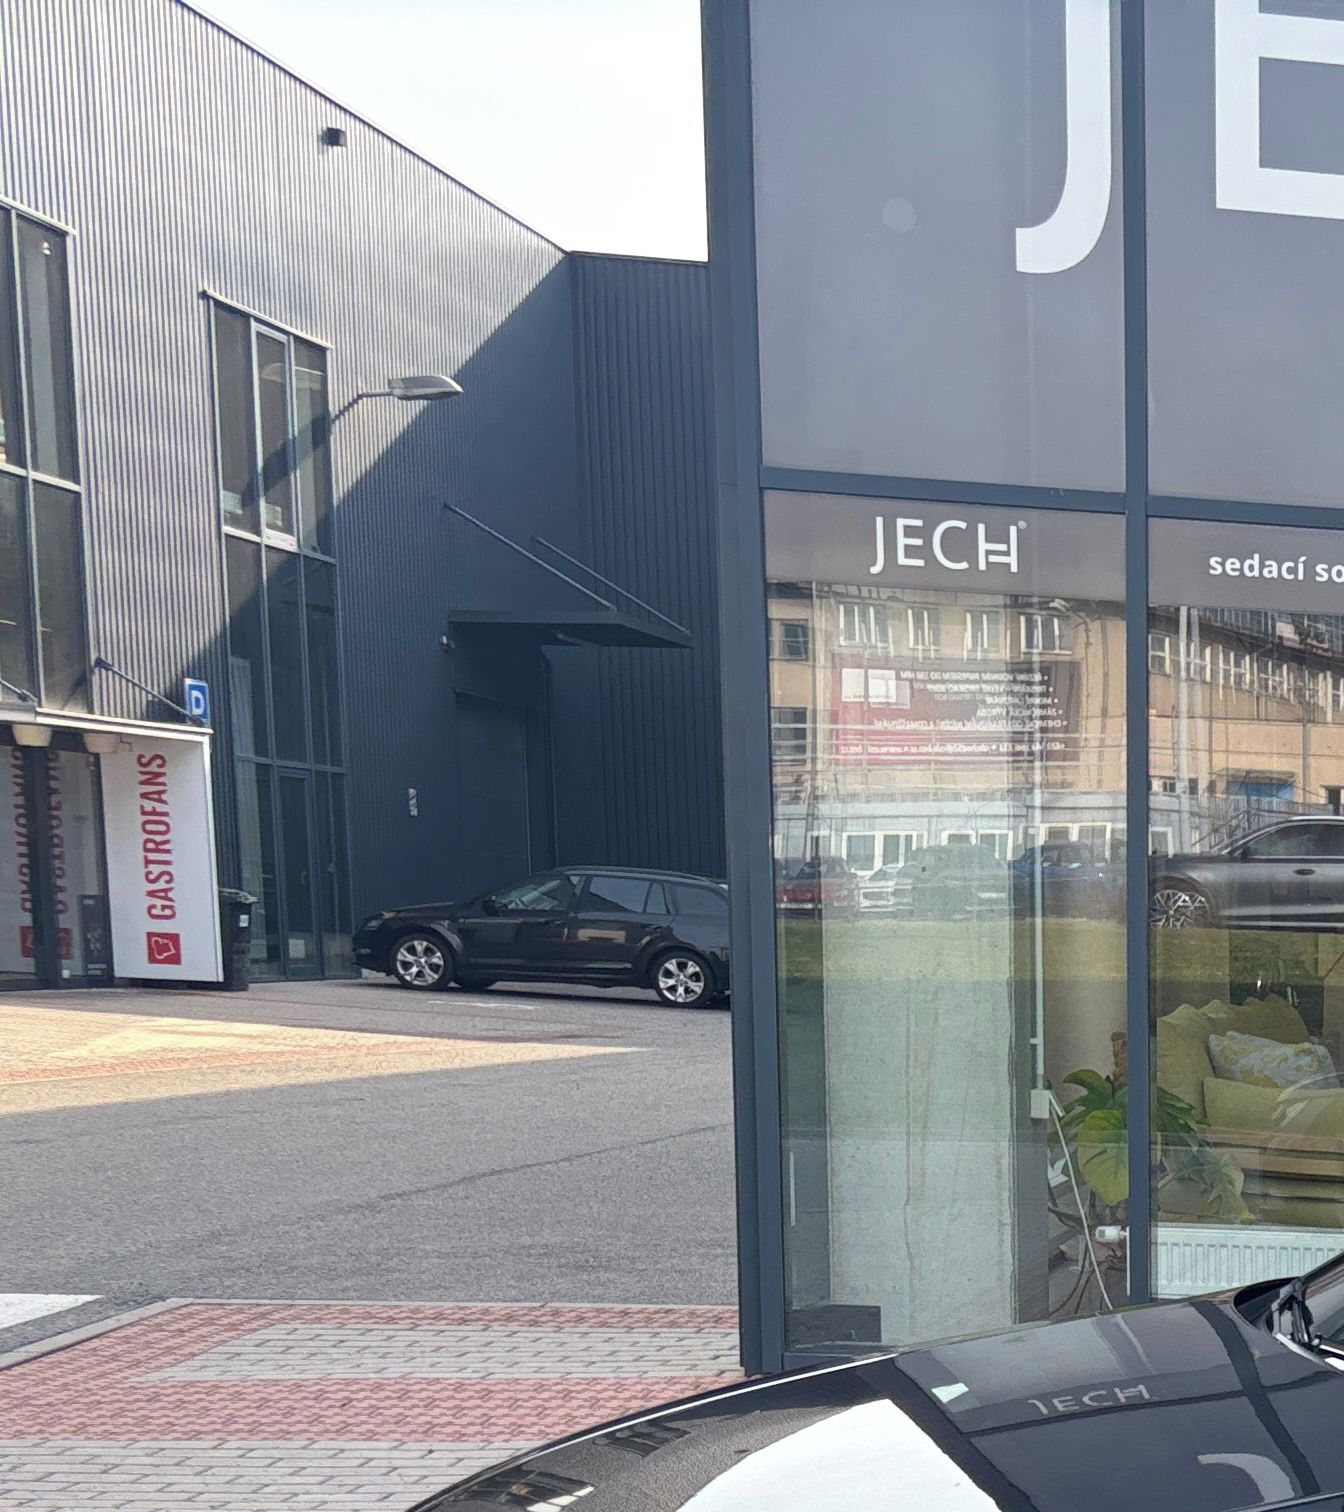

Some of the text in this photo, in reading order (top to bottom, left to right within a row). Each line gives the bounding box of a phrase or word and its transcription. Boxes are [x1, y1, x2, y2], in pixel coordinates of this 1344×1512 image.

[870, 515, 1019, 574] JECH
[1208, 551, 1307, 583] sedací
[136, 752, 177, 921] GASTROFANS
